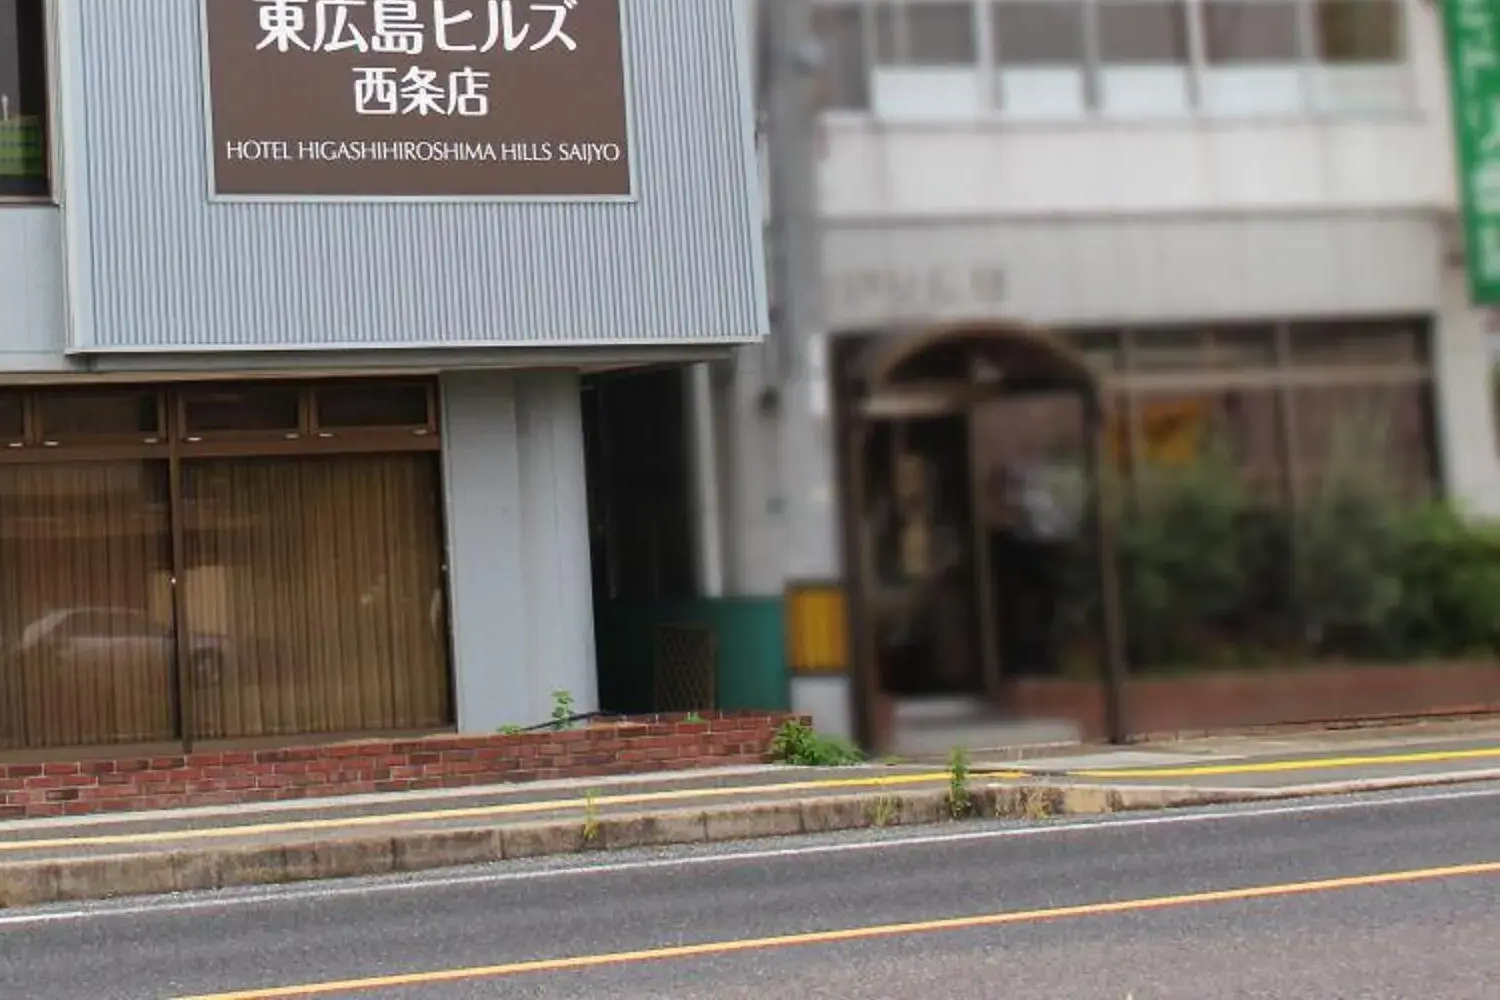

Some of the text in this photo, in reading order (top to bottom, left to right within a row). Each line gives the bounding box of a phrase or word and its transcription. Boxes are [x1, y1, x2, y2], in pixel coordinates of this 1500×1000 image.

[351, 65, 490, 117] 西条店
[226, 139, 621, 165] HOTEL HIGASHIHIROSHIMA HILLS SAIJYO
